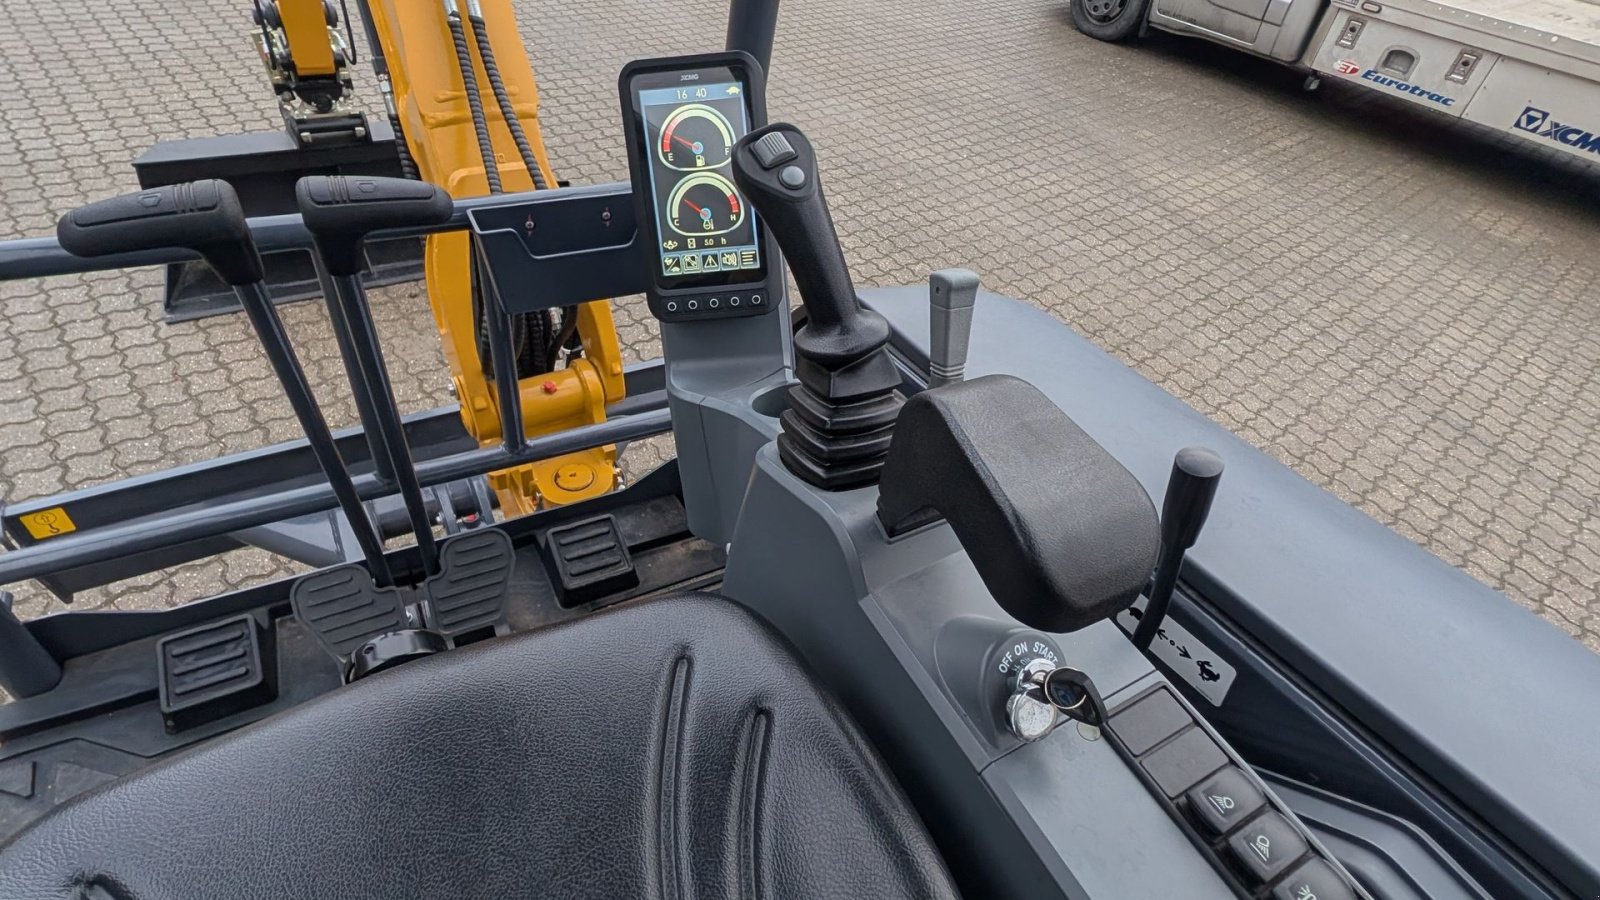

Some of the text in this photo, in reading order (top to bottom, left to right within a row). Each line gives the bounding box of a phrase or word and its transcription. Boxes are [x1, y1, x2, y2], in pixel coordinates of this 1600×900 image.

[680, 73, 699, 81] XCMG
[1361, 69, 1456, 106] Eurotrac
[677, 88, 707, 99] 16 40
[725, 147, 730, 155] F
[668, 153, 674, 161] E
[674, 218, 680, 226] C
[721, 237, 727, 245] h
[999, 651, 1013, 673] OFF
[1014, 641, 1028, 656] ON
[1033, 641, 1058, 663] START
